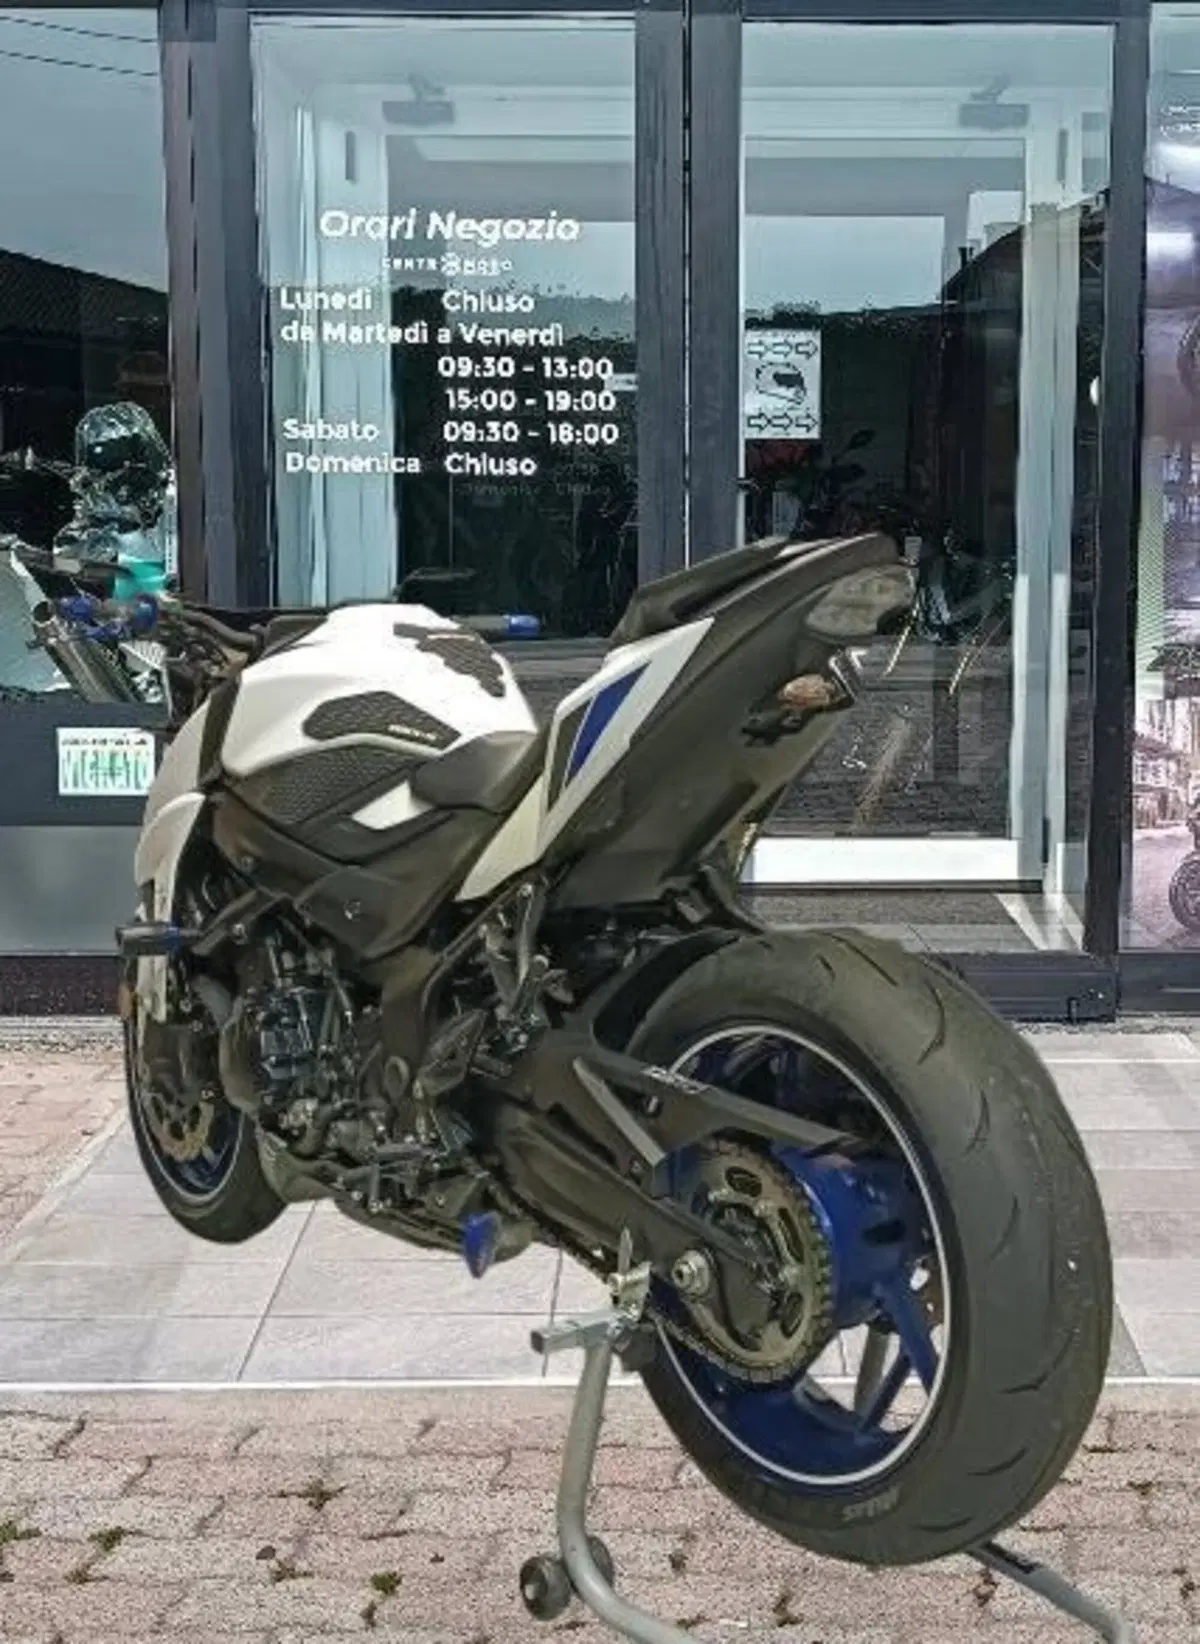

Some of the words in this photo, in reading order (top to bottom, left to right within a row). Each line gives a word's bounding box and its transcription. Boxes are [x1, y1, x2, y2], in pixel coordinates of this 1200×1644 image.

[319, 207, 417, 241] Orari
[426, 210, 581, 248] Negozio
[442, 289, 535, 313] Chiuso
[280, 320, 315, 342] da
[322, 320, 428, 344] Martedì
[437, 327, 451, 344] a
[458, 322, 564, 346] Venerdì
[437, 356, 516, 378] 09:30
[542, 356, 614, 380] 13:00
[445, 388, 517, 411] 15:00
[544, 389, 617, 412] 19:00
[282, 418, 380, 441] Sabato
[443, 420, 520, 442] 09:30
[285, 451, 421, 473] Domenica
[444, 452, 538, 476] Chiuso
